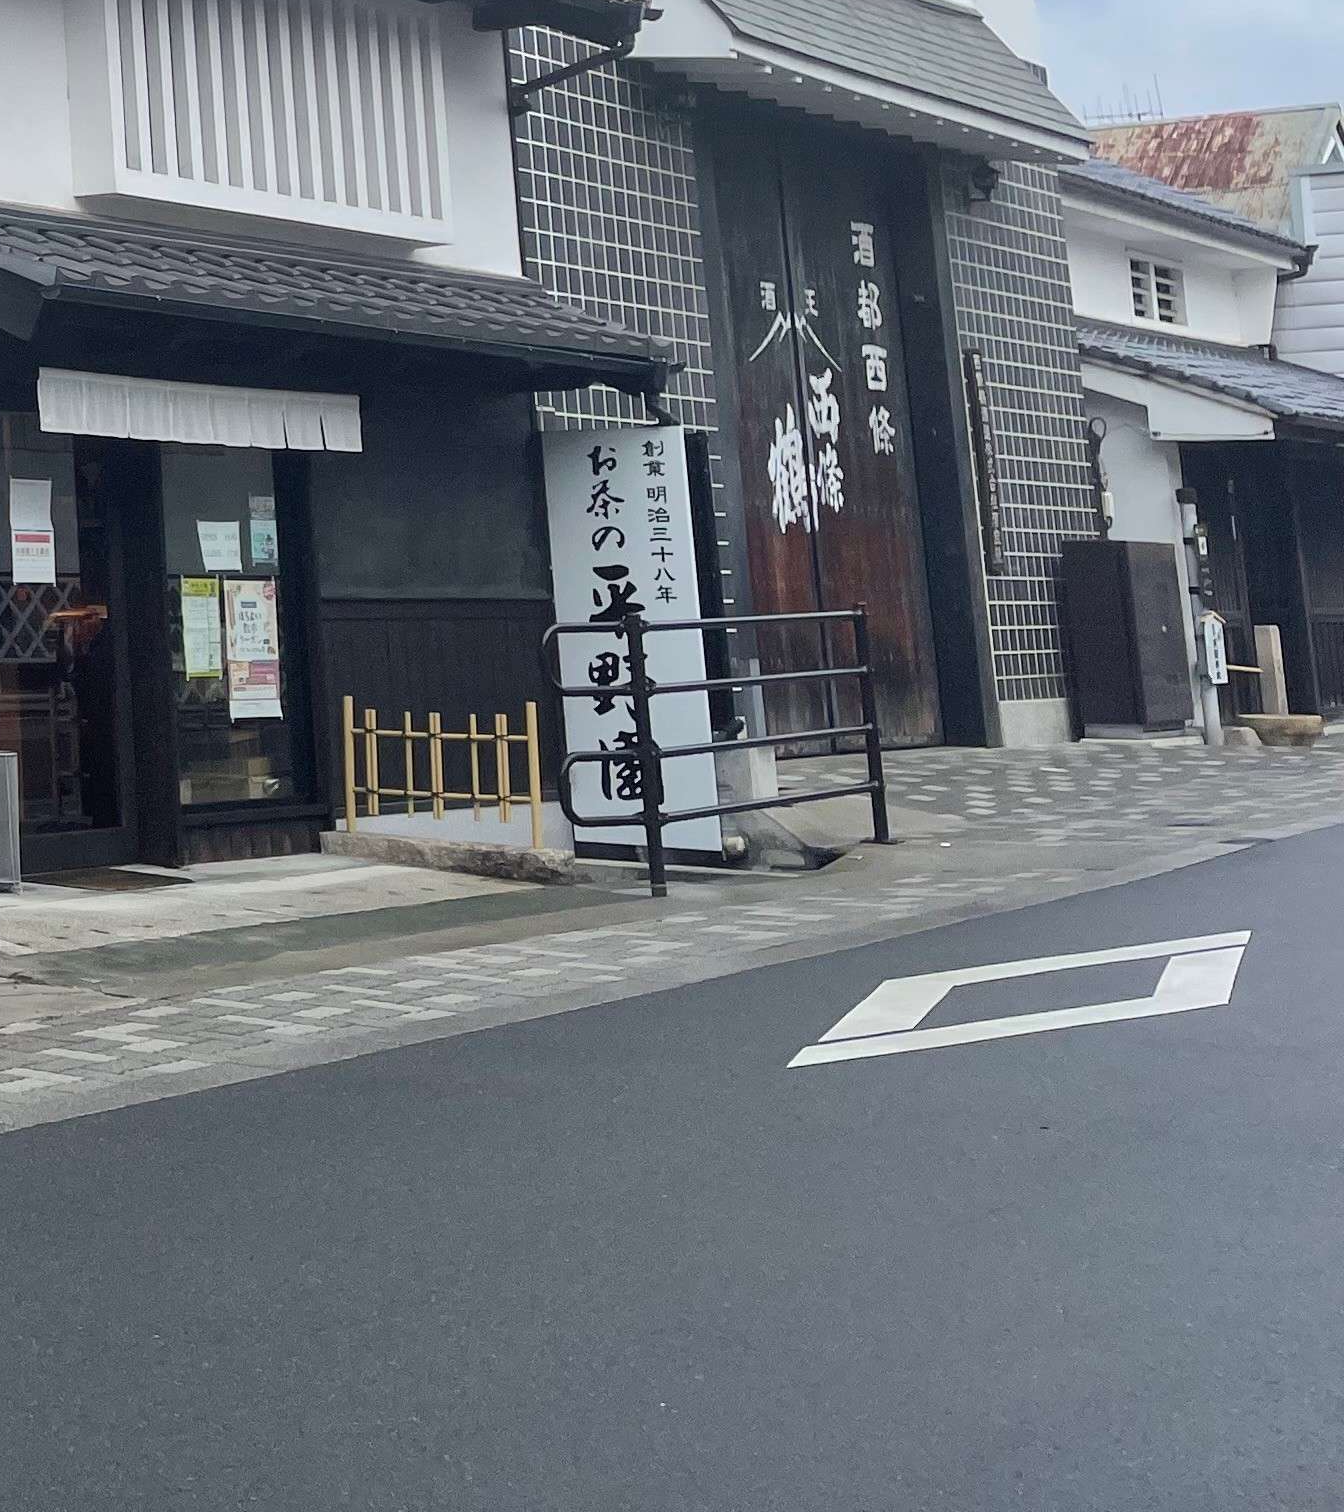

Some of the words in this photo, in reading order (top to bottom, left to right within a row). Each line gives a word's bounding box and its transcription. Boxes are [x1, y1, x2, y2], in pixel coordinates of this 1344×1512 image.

[850, 220, 898, 457] 酒都西條
[640, 439, 678, 606] 創業明治三十八年
